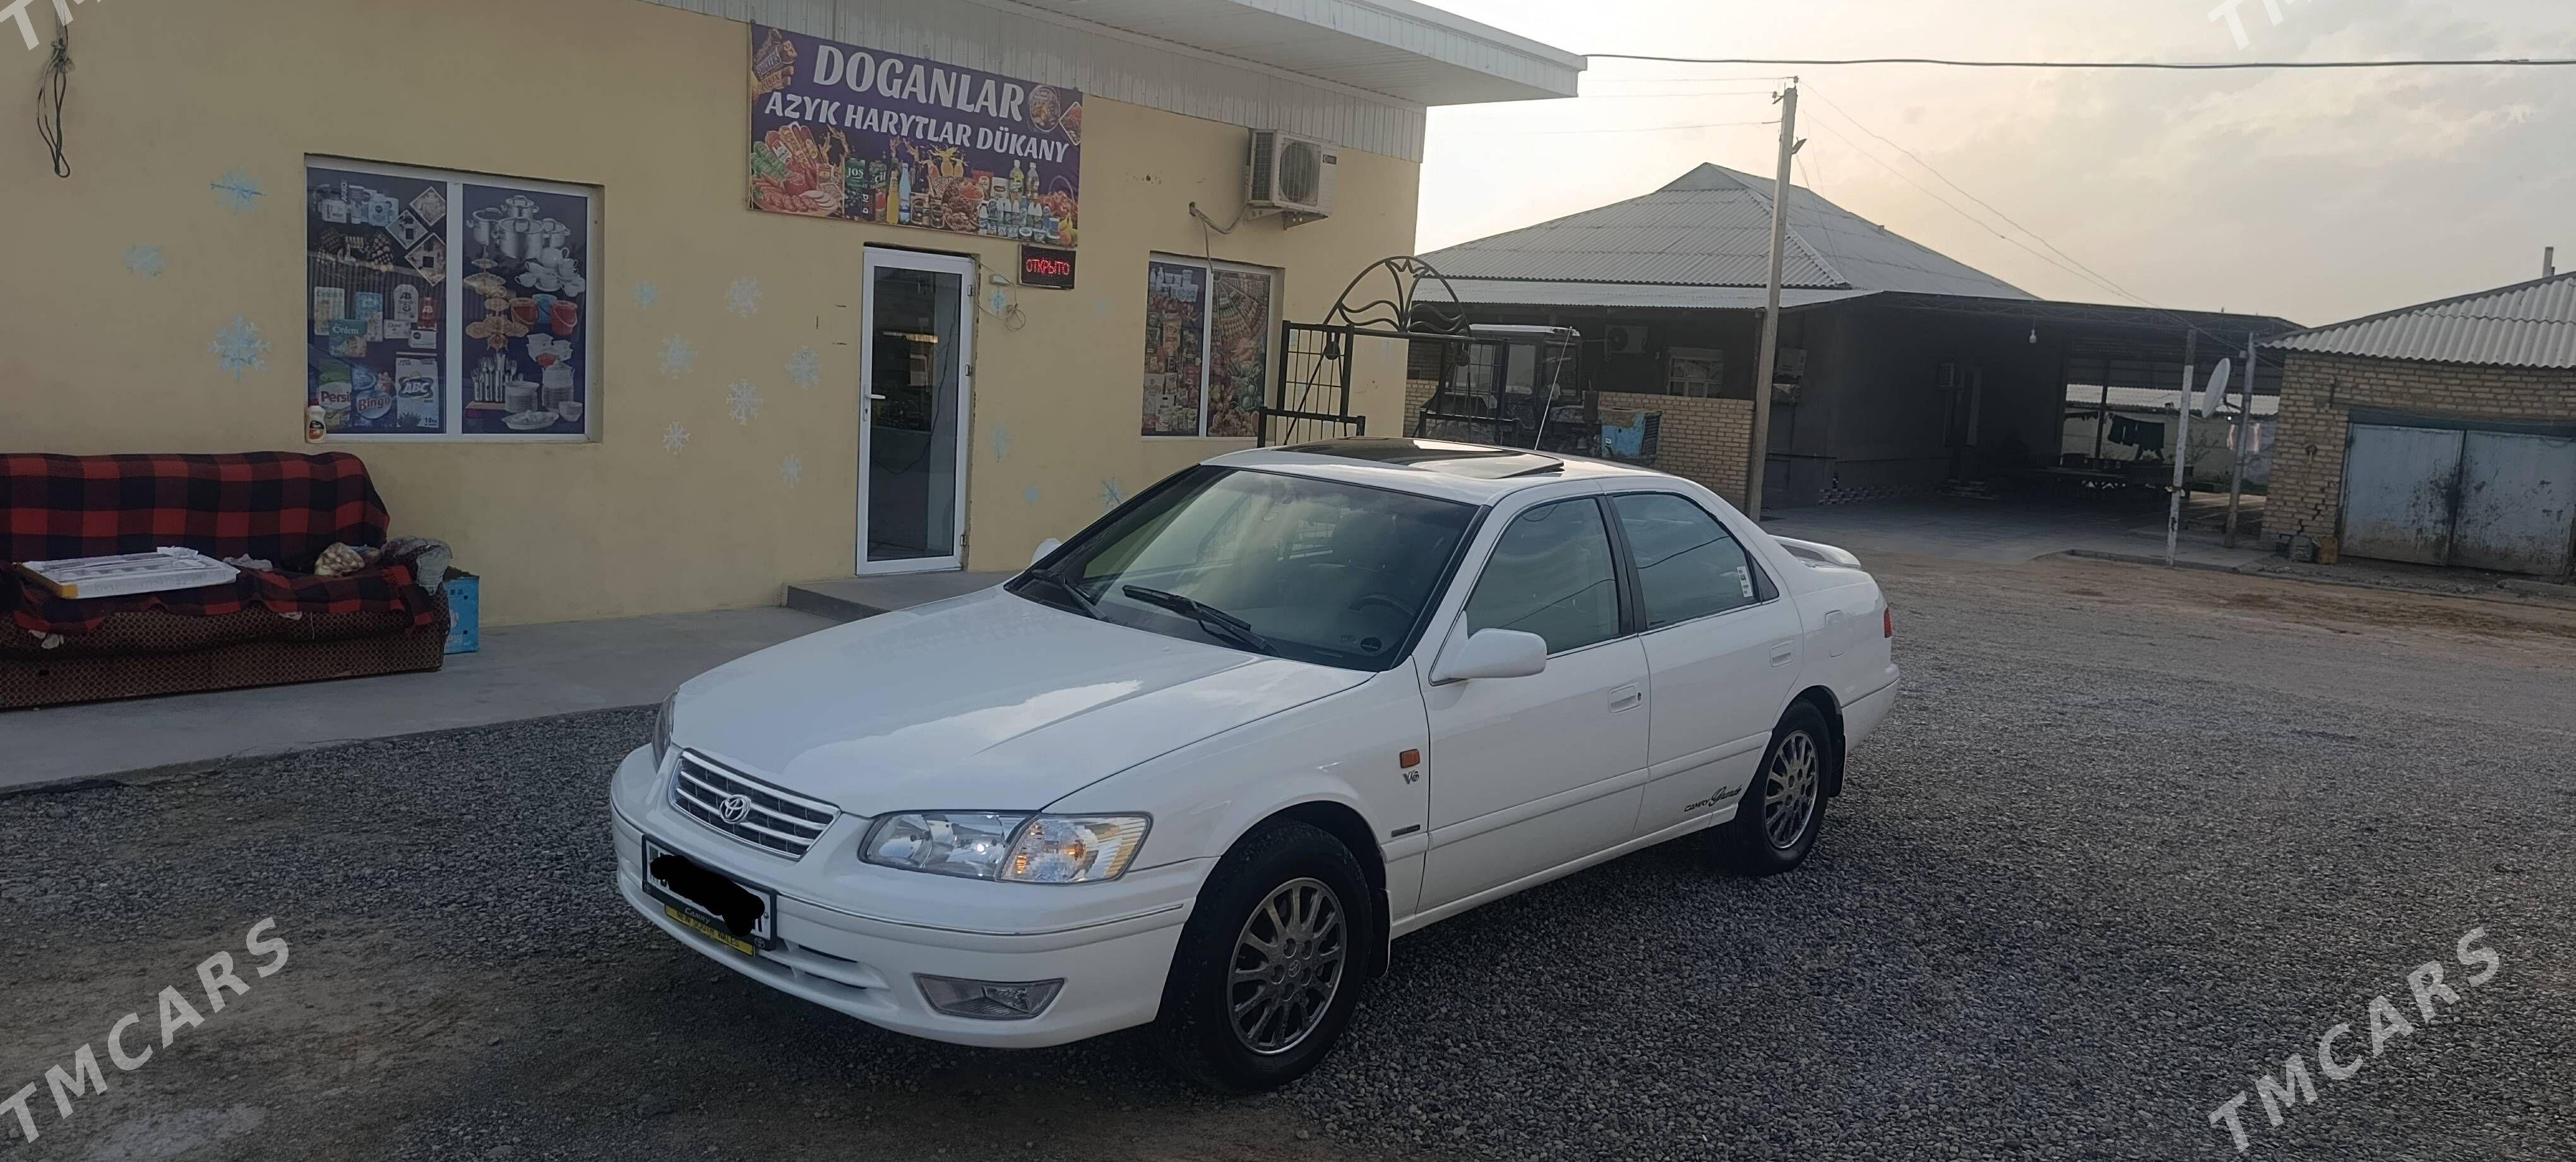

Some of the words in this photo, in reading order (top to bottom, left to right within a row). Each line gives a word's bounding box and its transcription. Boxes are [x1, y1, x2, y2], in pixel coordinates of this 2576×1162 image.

[813, 44, 1025, 123] DOGANLAR
[765, 91, 840, 125] AZYK
[845, 104, 971, 147] HARYTLAR
[977, 126, 1071, 163] DÜKANY
[1026, 258, 1070, 275] ОТКРЫТО
[403, 381, 430, 393] ABC
[358, 397, 390, 412] Bingo
[1402, 769, 1420, 785] V6
